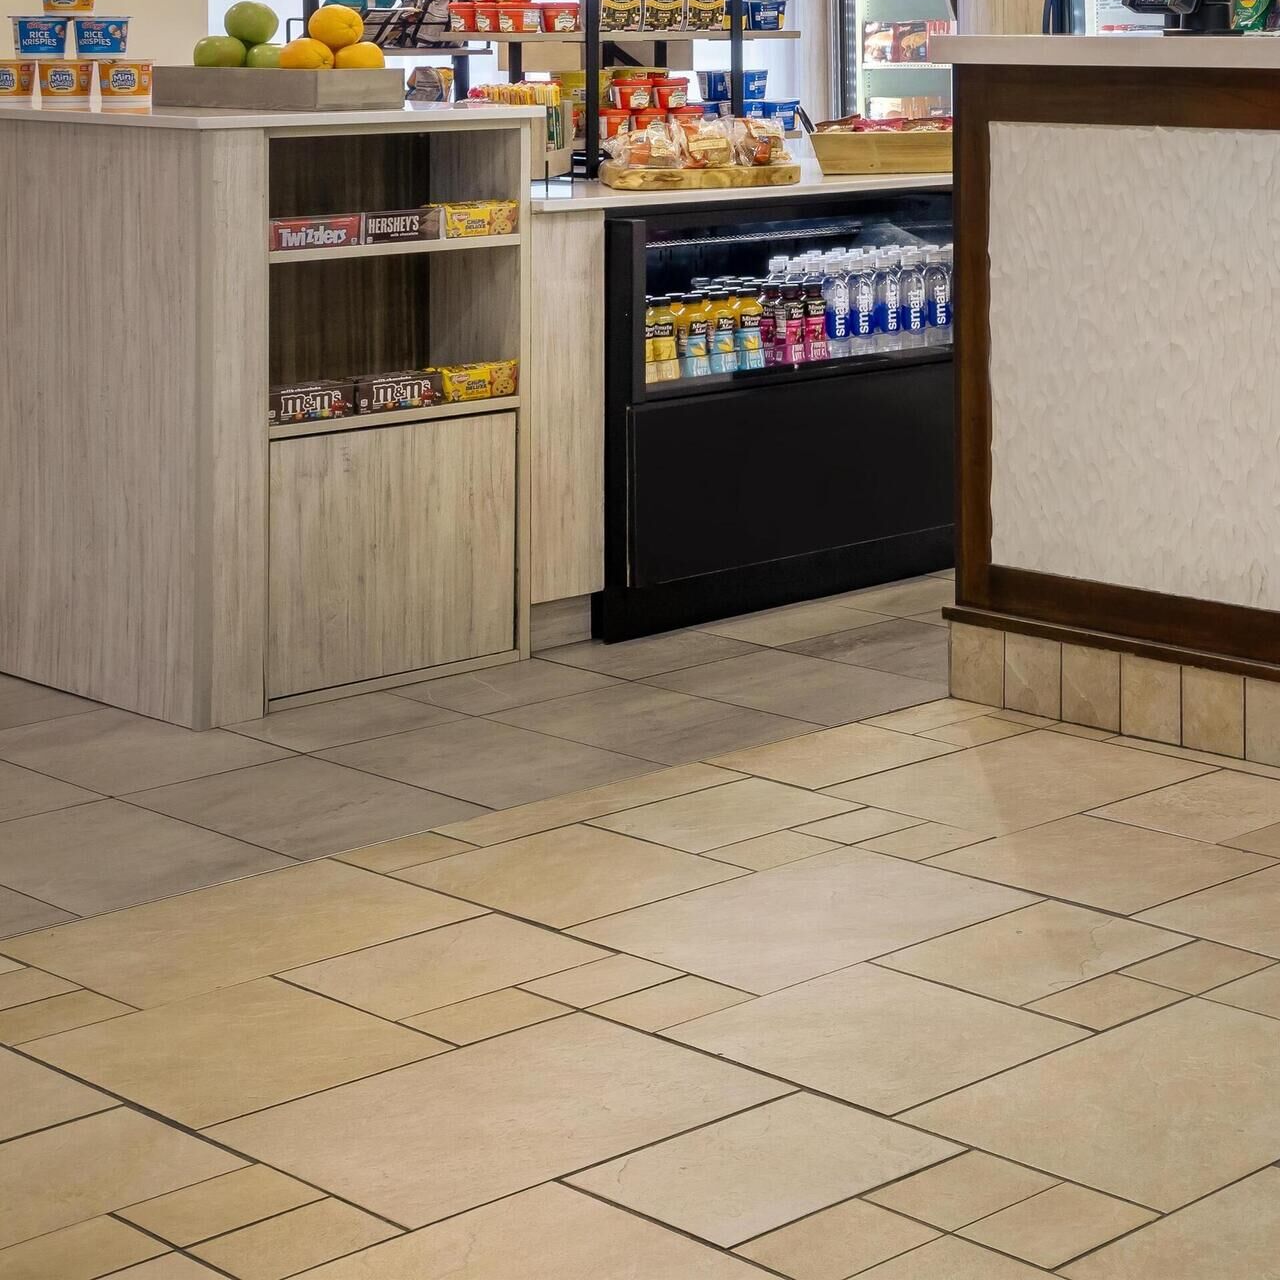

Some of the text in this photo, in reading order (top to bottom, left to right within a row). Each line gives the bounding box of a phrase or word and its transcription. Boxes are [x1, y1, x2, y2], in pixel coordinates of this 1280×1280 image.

[83, 31, 104, 39] RICE
[22, 38, 57, 46] KRISPIES
[79, 38, 112, 46] KRISPIES
[51, 73, 72, 81] Mini
[113, 73, 135, 81] Mini
[368, 215, 420, 234] HERSHEY'S
[278, 226, 347, 248] Twizzlers
[934, 284, 946, 325] smart
[908, 289, 921, 330] smart
